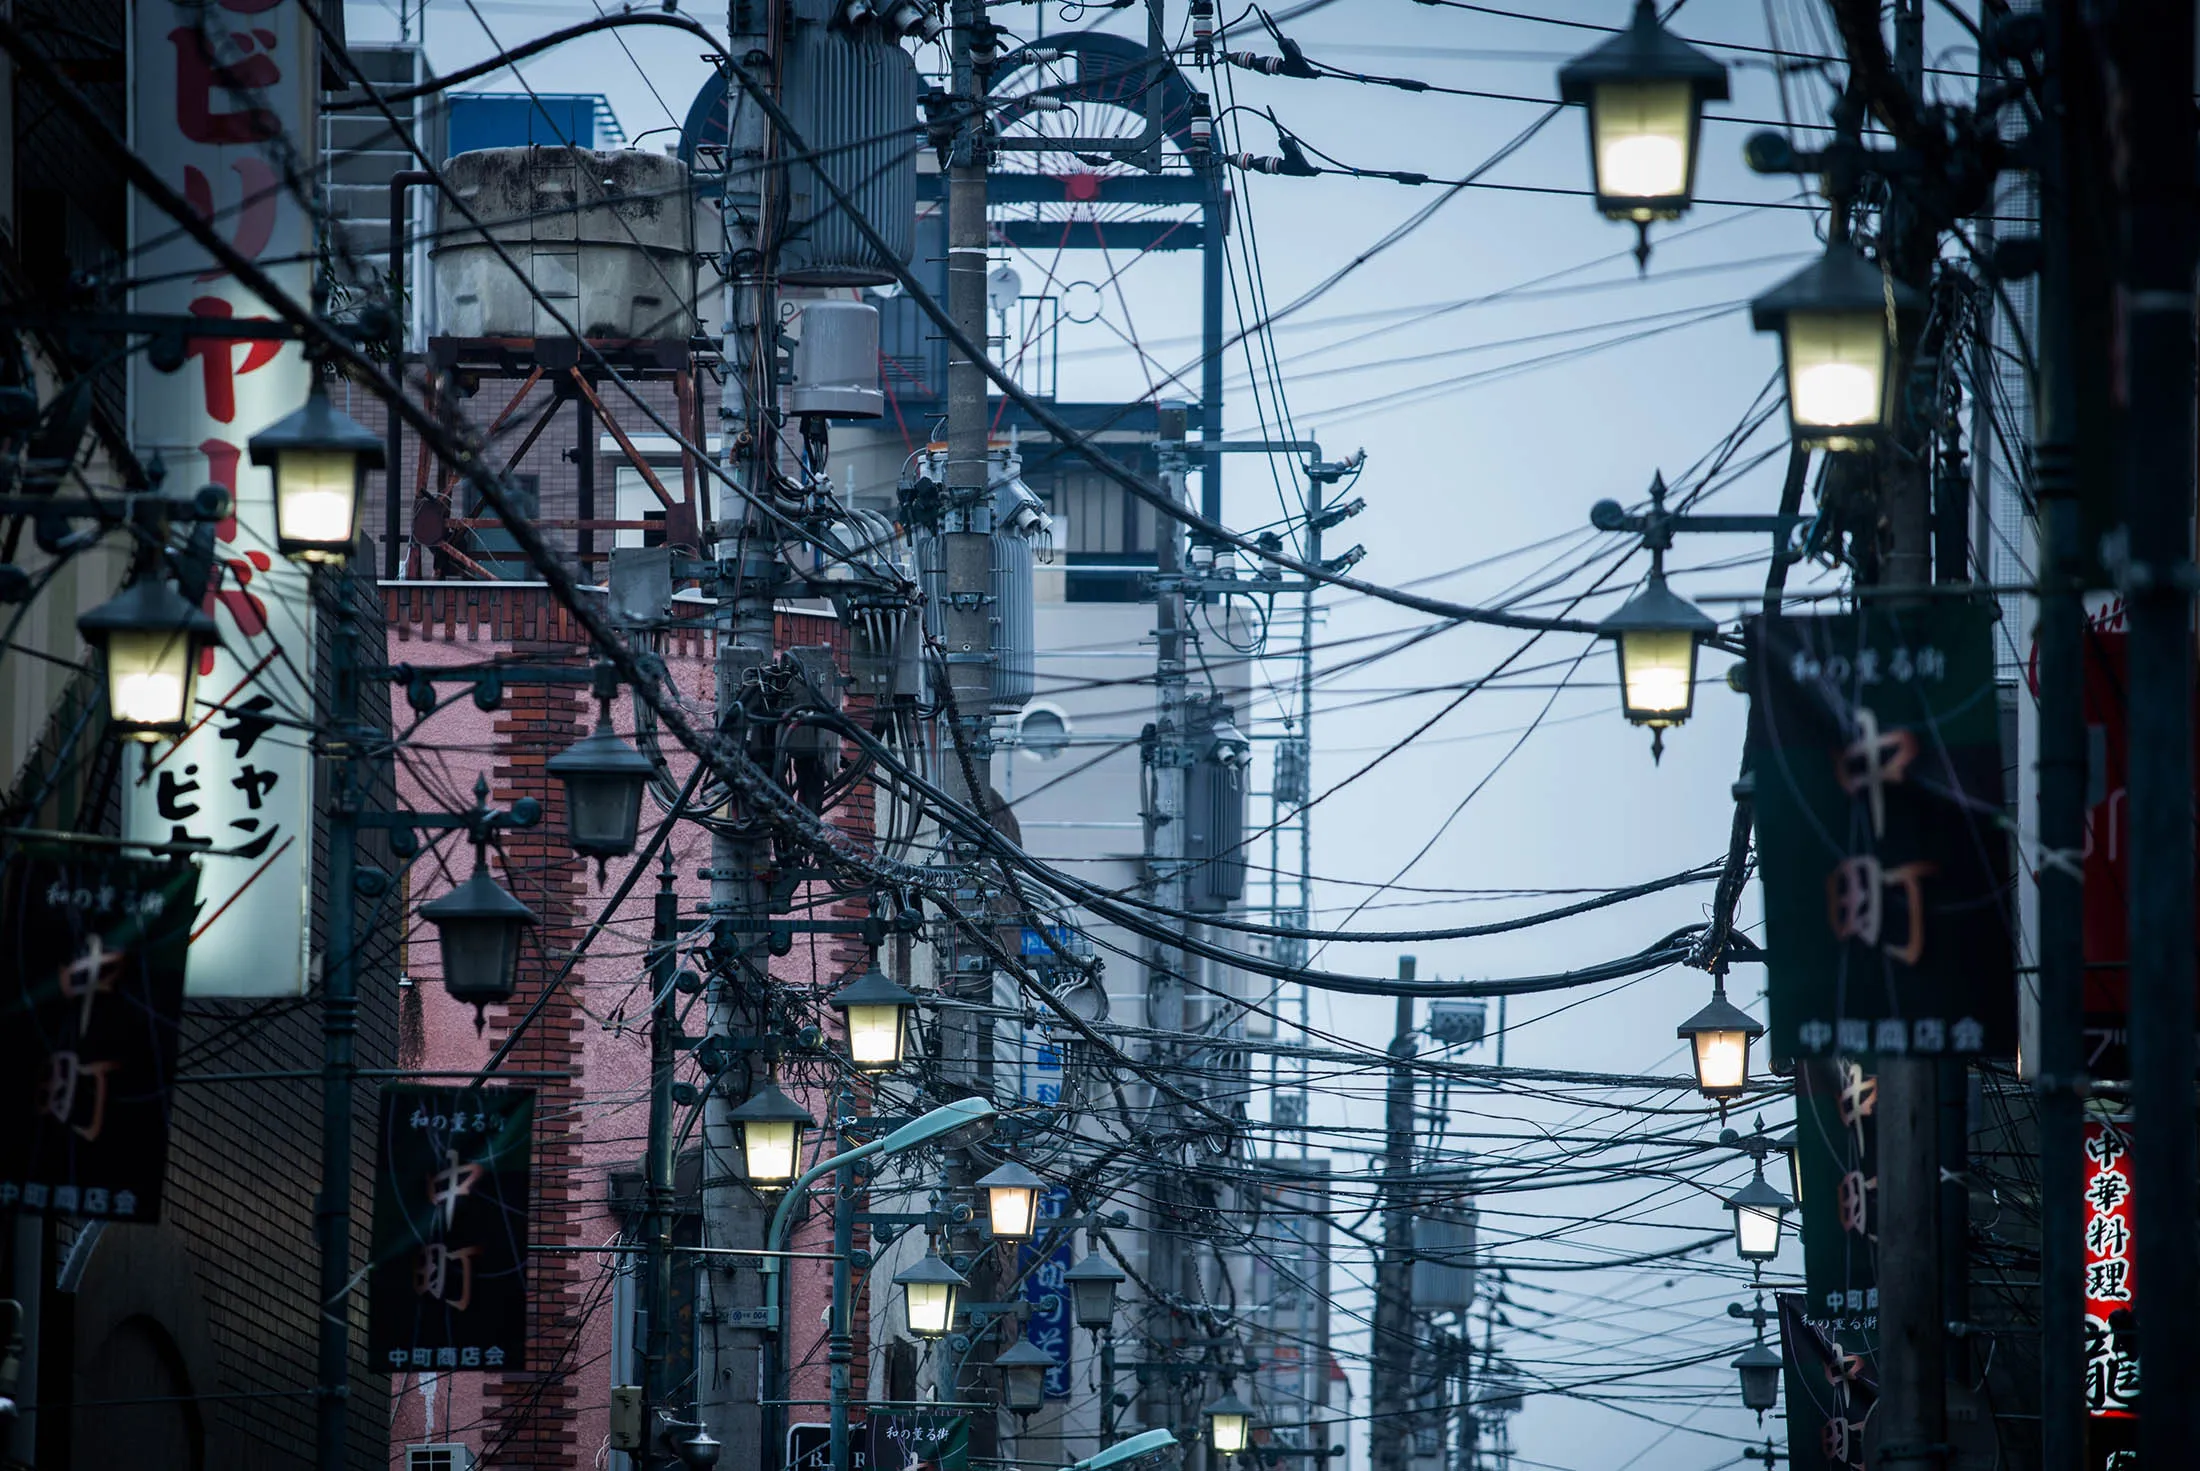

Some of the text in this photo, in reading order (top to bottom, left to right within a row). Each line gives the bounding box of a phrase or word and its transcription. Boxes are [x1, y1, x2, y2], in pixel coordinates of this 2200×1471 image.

[1828, 705, 1940, 966] 中町
[33, 932, 126, 1142] 中町
[1799, 1016, 1985, 1053] 中町商店会
[413, 1148, 486, 1312] 中町
[2086, 1130, 2131, 1298] 中華料理
[388, 1345, 505, 1368] 中町商店会
